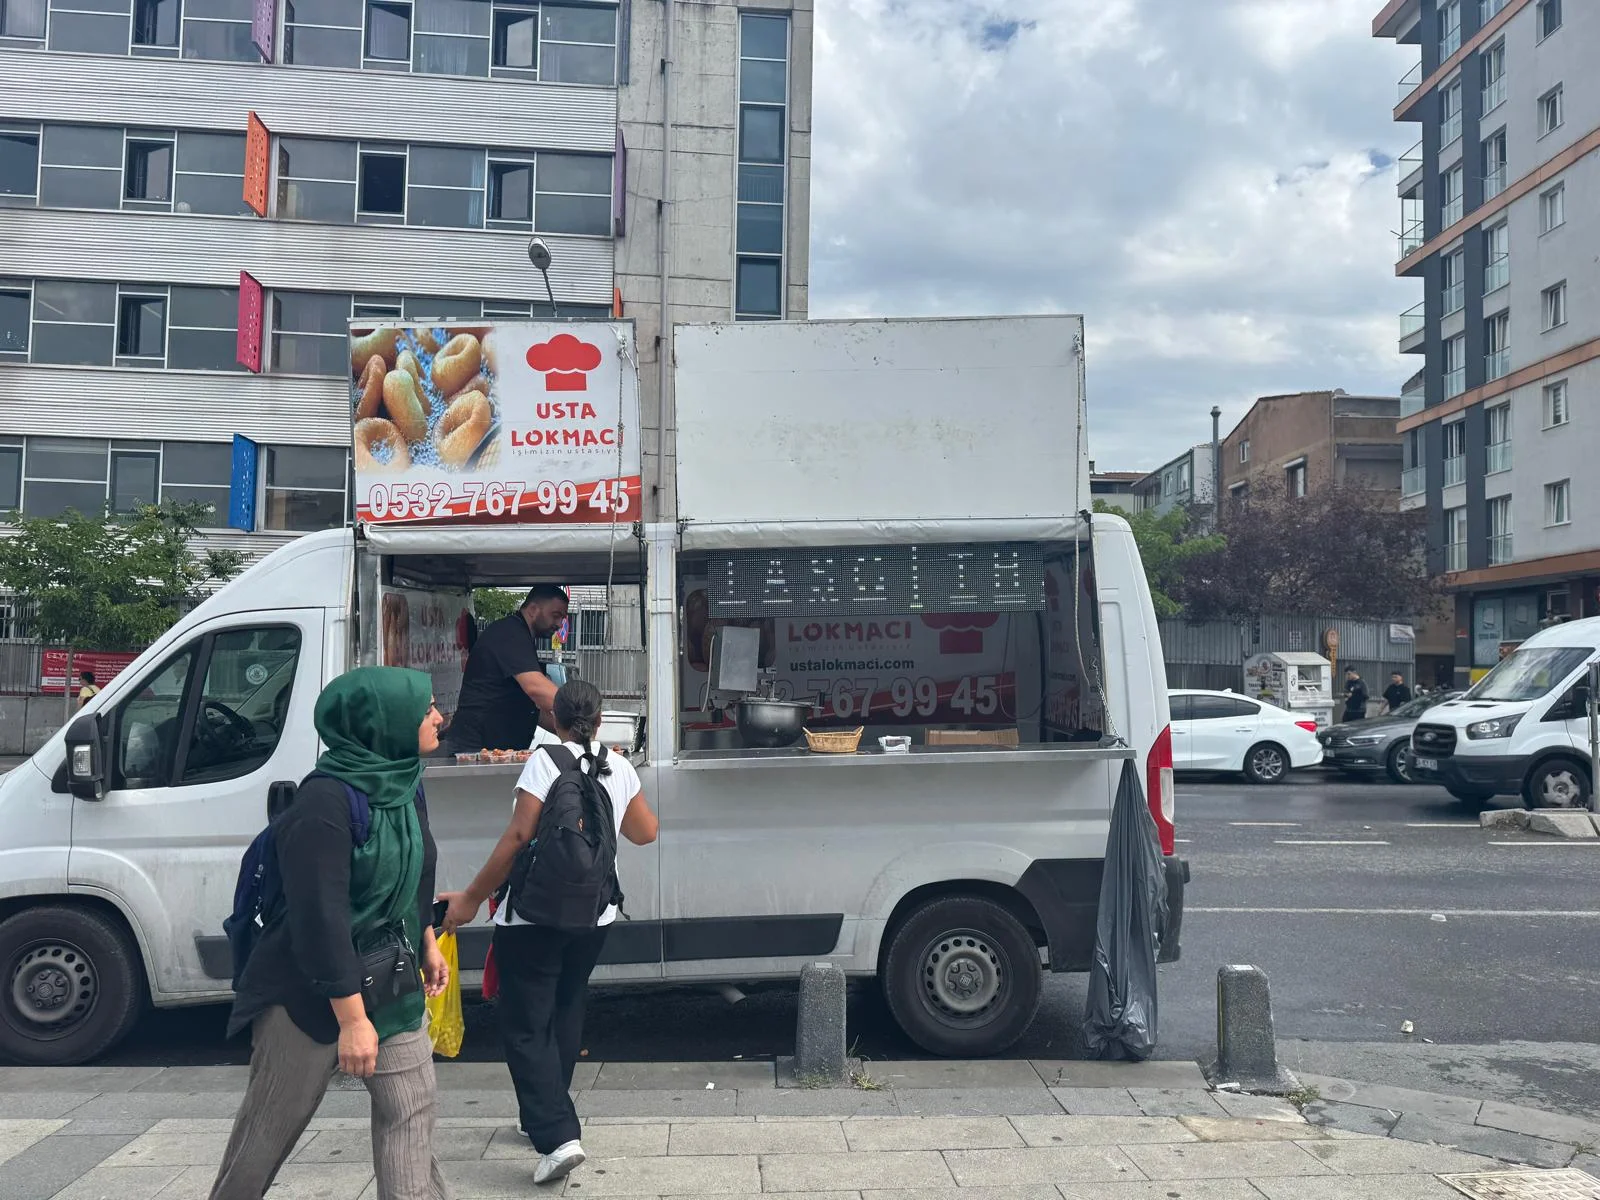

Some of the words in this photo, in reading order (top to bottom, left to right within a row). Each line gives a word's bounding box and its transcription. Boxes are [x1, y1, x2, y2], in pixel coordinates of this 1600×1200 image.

[536, 402, 597, 420] USTA
[567, 447, 621, 456] ustasıyı
[369, 483, 453, 519] 0532
[463, 482, 526, 517] 767
[536, 480, 578, 516] 99
[588, 479, 630, 515] 45
[788, 621, 911, 643] LOKMACI
[790, 657, 914, 672] ustalokmaci.com
[807, 677, 878, 719] 767
[891, 676, 937, 717] 99
[950, 676, 998, 716] 45
